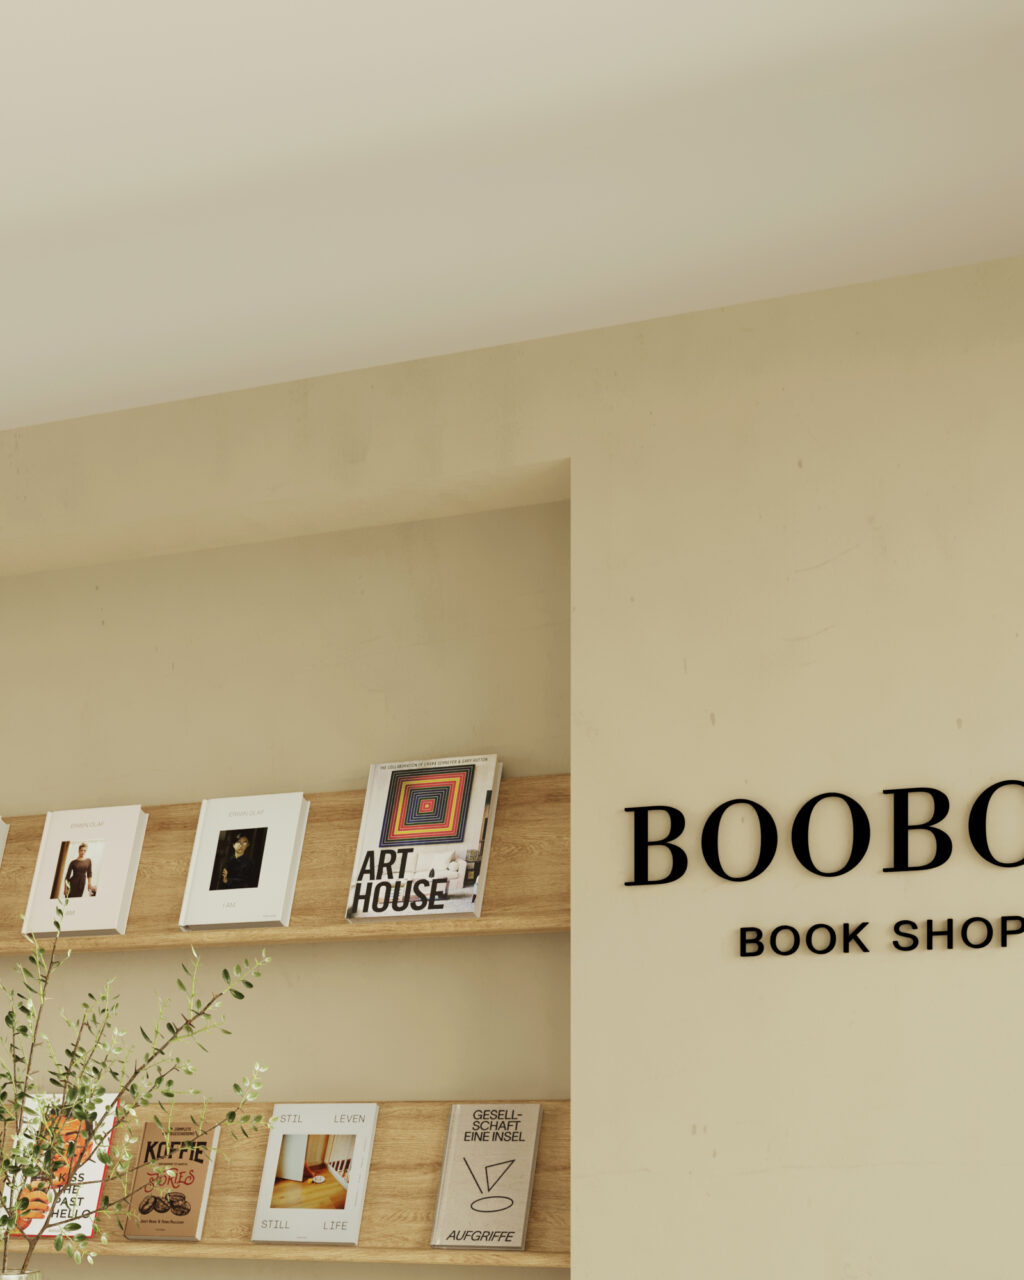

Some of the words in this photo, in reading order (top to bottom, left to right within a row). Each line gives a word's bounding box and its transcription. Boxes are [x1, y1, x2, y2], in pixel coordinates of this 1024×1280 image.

[624, 779, 1024, 886] BOOBO
[357, 848, 414, 882] ART
[352, 878, 447, 913] HOUSE
[739, 922, 870, 958] BOOK
[892, 916, 1024, 952] SHOP
[280, 1114, 303, 1123] STIL
[334, 1114, 366, 1123] LEVEN
[472, 1109, 523, 1120] GESELL-
[472, 1121, 521, 1131] SCHAFT
[463, 1131, 490, 1142] EINE
[491, 1131, 526, 1142] INSEL
[144, 1141, 207, 1163] KOFFIE
[59, 1173, 85, 1182] KSS
[56, 1197, 85, 1206] PAST
[50, 1209, 91, 1219] HELLO
[261, 1220, 290, 1229] STILL
[322, 1221, 349, 1230] LIFE
[446, 1230, 515, 1242] AUFGRIFFE
